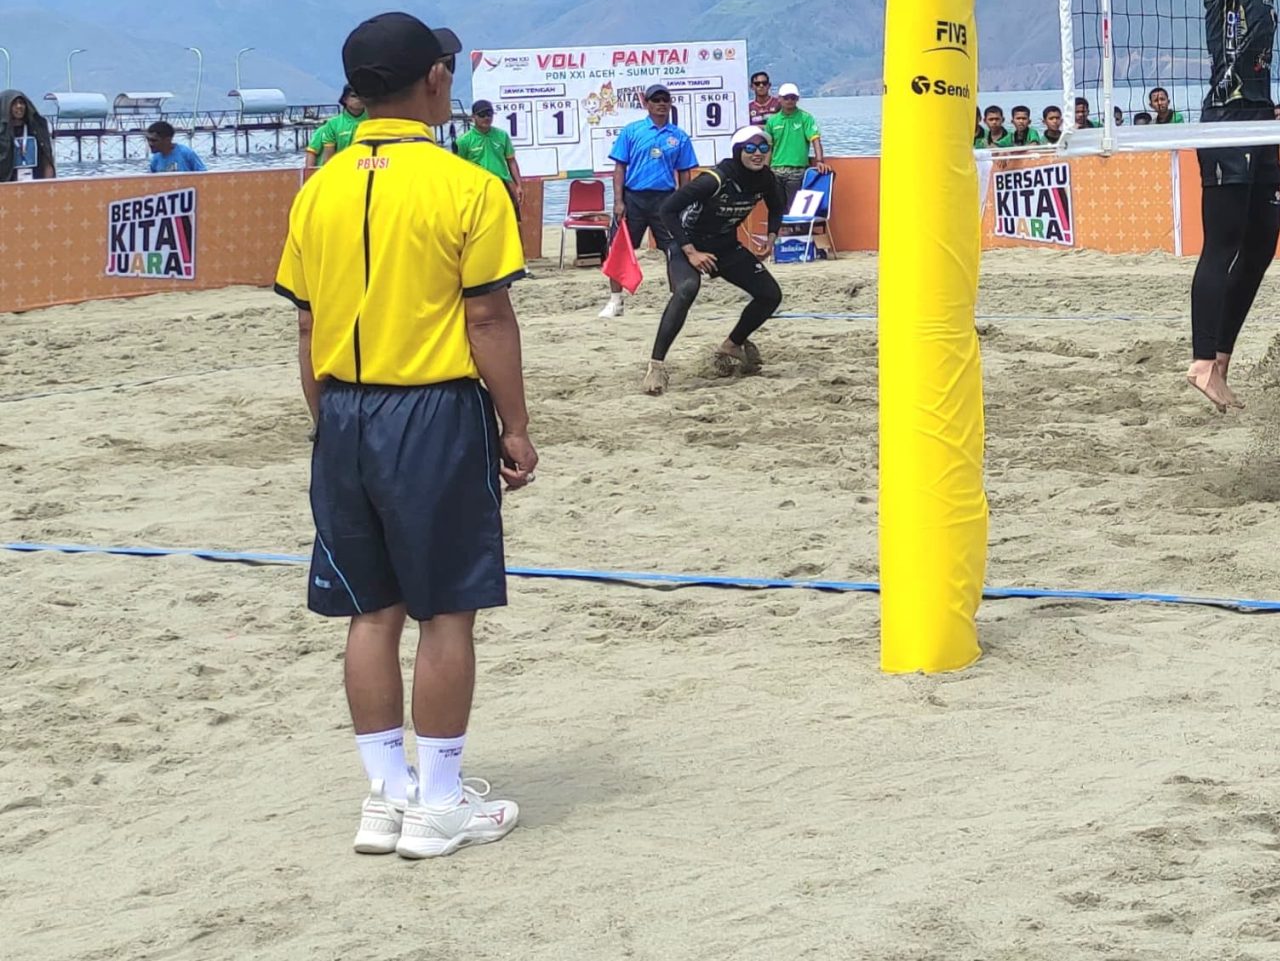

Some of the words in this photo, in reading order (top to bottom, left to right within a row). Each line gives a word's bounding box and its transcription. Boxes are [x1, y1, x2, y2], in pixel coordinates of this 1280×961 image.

[537, 52, 585, 69] VOLI
[612, 49, 688, 66] PANTAI
[546, 71, 566, 80] PON
[570, 70, 585, 79] XXI
[589, 69, 615, 78] ACEH
[627, 68, 660, 76] SUMUT
[663, 66, 686, 75] 2024
[542, 101, 571, 109] SKOR
[701, 93, 729, 101] SKOR
[506, 112, 517, 137] 1
[553, 111, 564, 135] 1
[706, 102, 722, 127] 9
[606, 129, 620, 137] SE
[357, 157, 389, 170] PBVSI
[995, 165, 1067, 190] BERSATU
[111, 190, 193, 223] BERSATU
[802, 194, 814, 214] 1
[997, 188, 1057, 218] KITA
[111, 216, 178, 252] KITA
